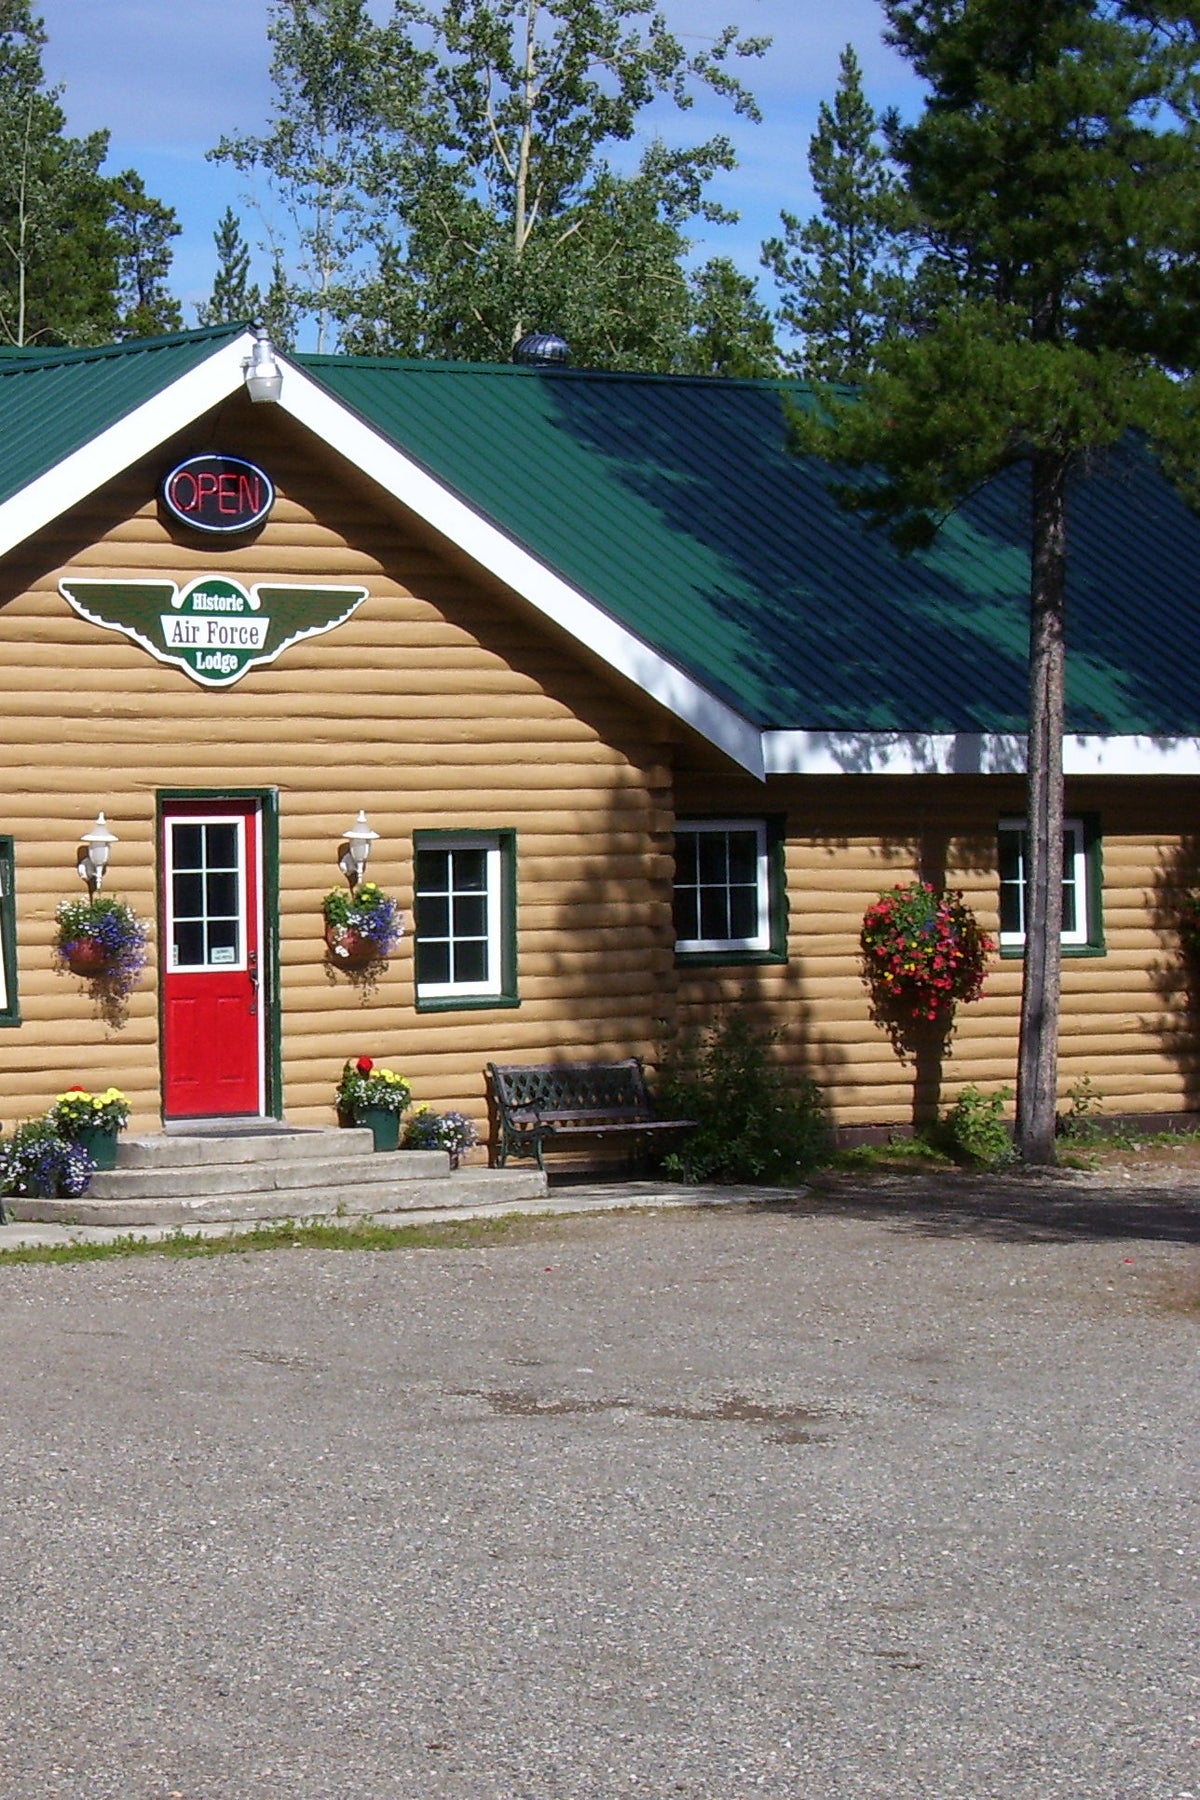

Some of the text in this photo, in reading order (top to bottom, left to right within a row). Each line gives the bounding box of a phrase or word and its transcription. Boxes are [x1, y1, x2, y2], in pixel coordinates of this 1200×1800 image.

[171, 471, 260, 514] OPEN
[192, 592, 244, 612] Historic
[172, 620, 259, 645] Air Force
[195, 651, 238, 674] Lodge
